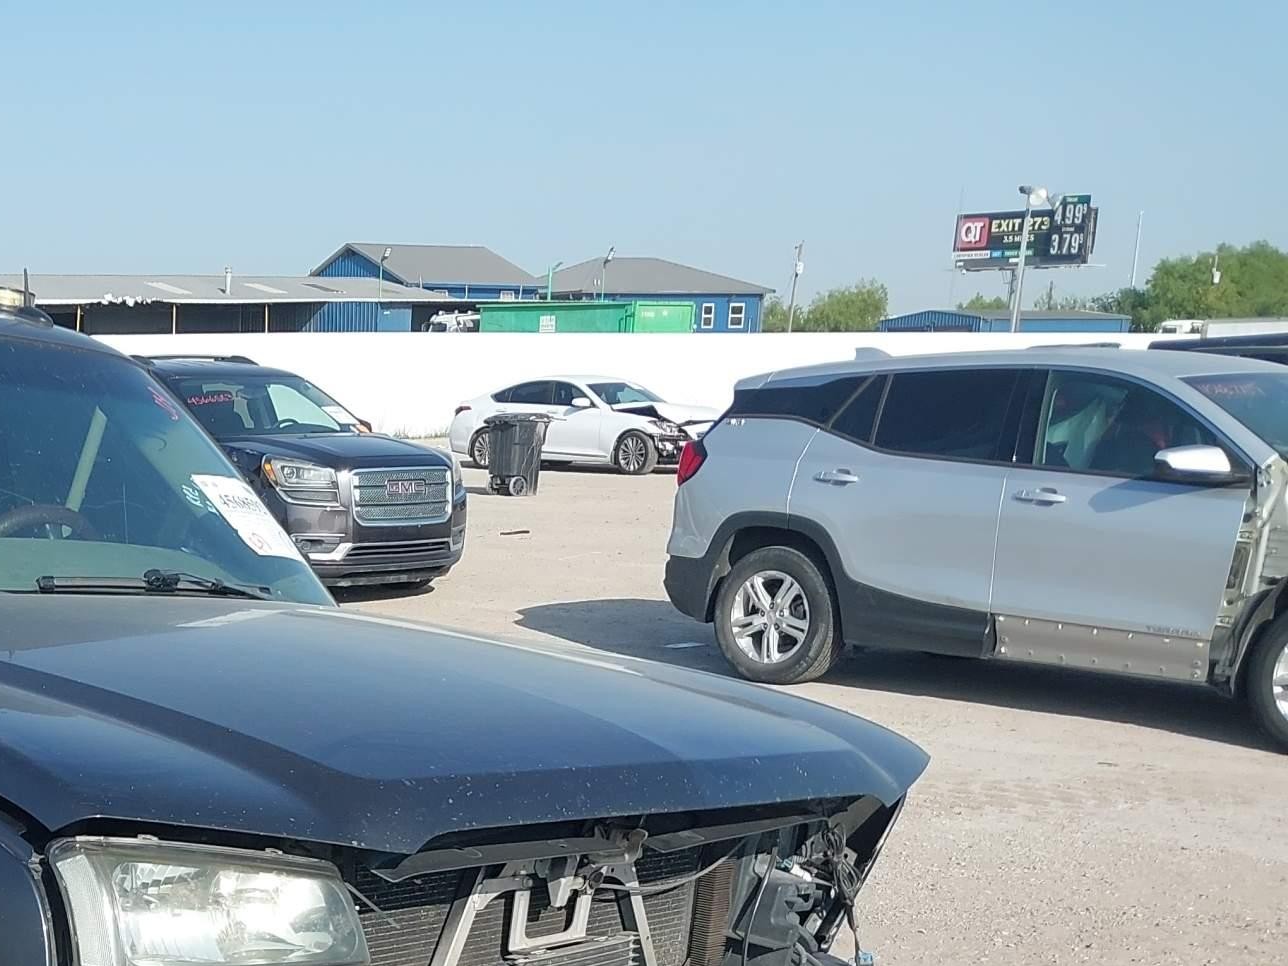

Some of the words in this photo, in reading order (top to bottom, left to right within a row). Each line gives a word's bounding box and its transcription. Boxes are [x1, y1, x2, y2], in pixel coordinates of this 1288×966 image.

[961, 222, 984, 243] QT
[991, 219, 1022, 233] EXIT
[1027, 216, 1050, 231] 273
[387, 480, 426, 494] GMC
